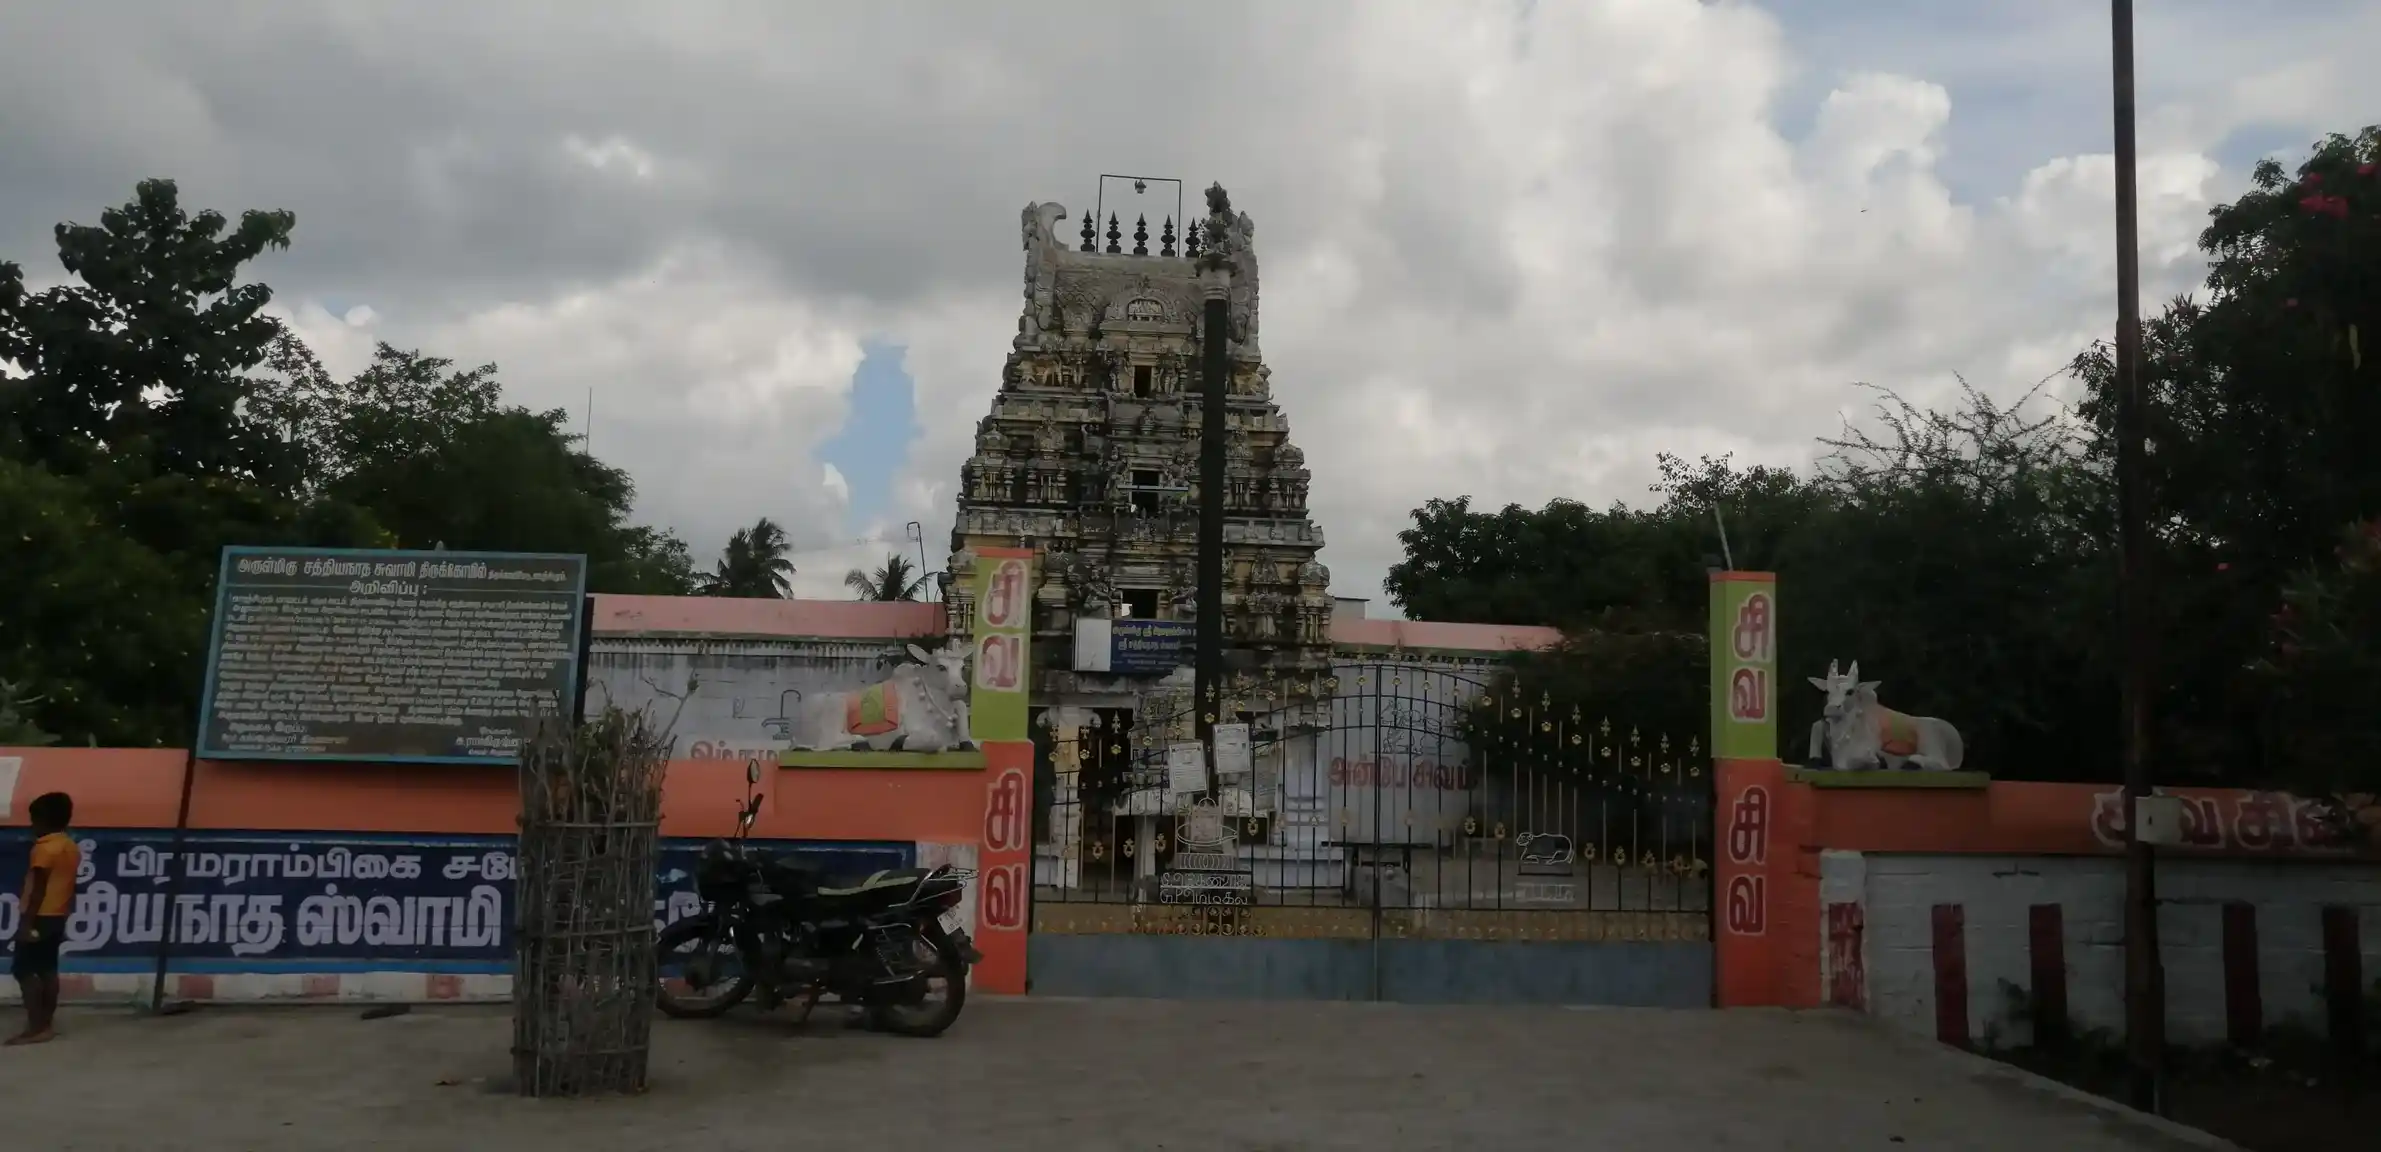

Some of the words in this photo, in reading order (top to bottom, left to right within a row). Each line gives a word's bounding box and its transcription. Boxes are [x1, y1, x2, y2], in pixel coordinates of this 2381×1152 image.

[239, 557, 298, 575] அருள்மிகு
[304, 558, 371, 578] சத்தியநாத
[374, 560, 416, 578] சுவாமி
[350, 580, 419, 598] அறிவிப்பு
[1731, 592, 1772, 721] சிவ
[117, 843, 421, 886] பிரமராம்பிகை
[984, 769, 1026, 931] சிவ
[1727, 786, 1769, 935] சிவ
[297, 883, 502, 947] ஸ்வாமி
